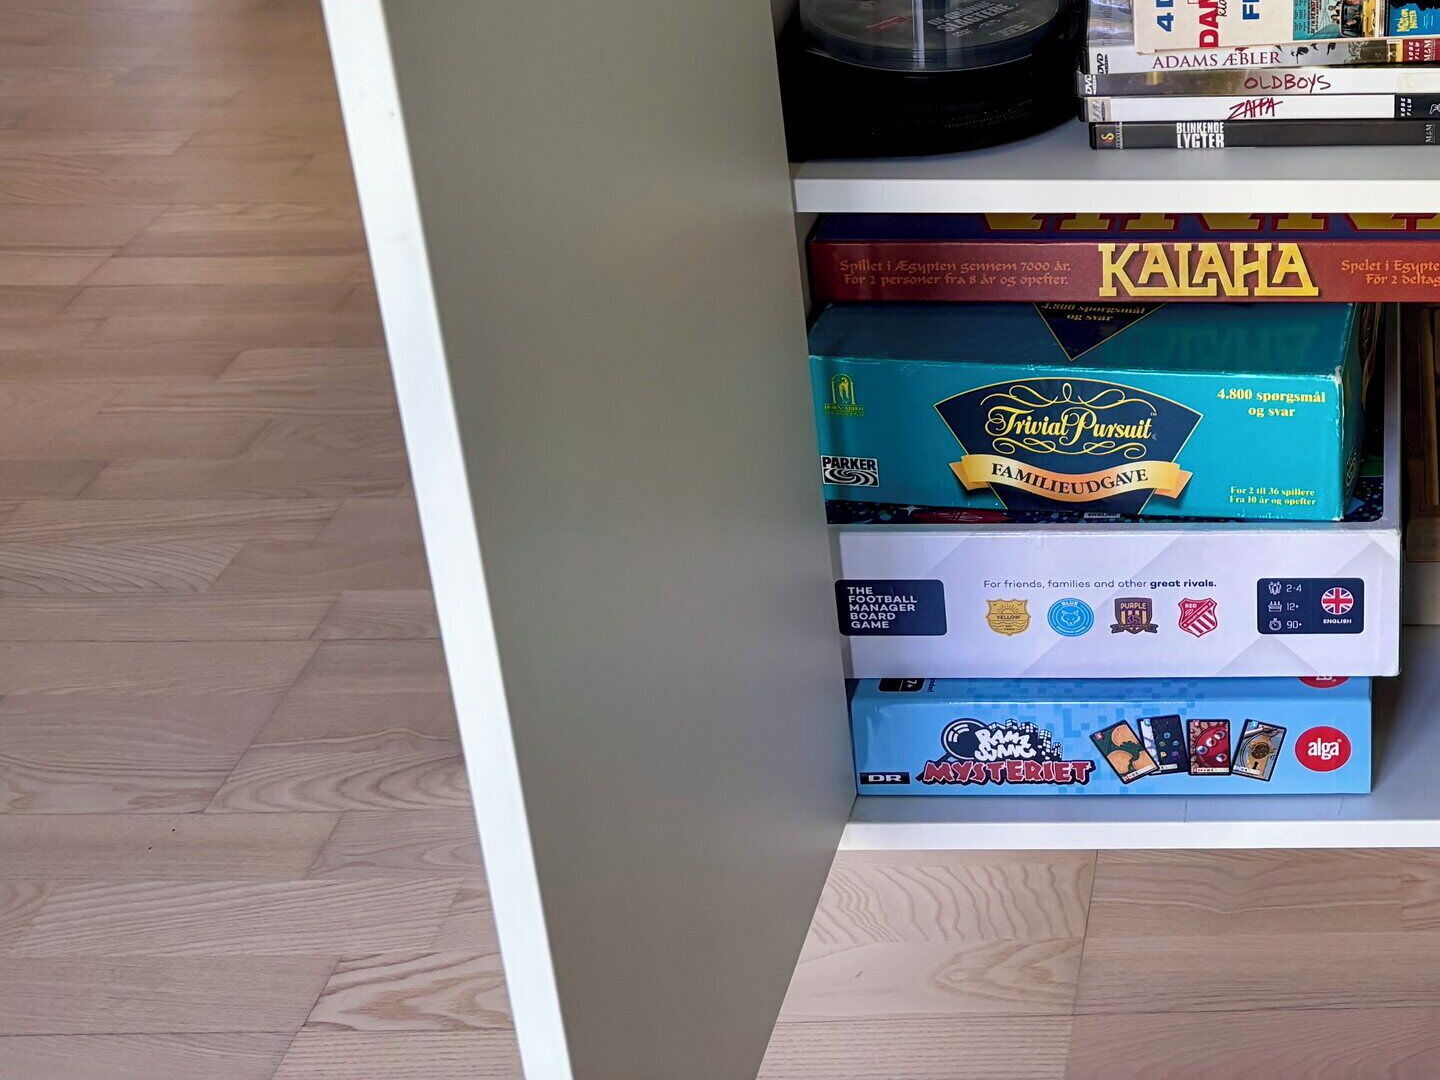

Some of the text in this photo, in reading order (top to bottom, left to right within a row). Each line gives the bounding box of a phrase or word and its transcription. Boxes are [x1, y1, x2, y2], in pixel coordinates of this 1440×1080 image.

[1156, 12, 1174, 32] 4
[1152, 51, 1282, 69] ADAMS ÆBLER
[1245, 74, 1332, 95] OLDBOYS
[1227, 96, 1284, 120] ZAPPA
[1176, 122, 1225, 134] BLINKENDE
[1176, 133, 1225, 149] LYGTER
[1097, 242, 1319, 297] KALAHA
[1341, 260, 1383, 275] Spelet
[1216, 388, 1326, 404] 4.800 spørgsmål
[1247, 407, 1296, 418] og svar
[985, 406, 1153, 446] Trivial Pursuit
[822, 456, 877, 471] PARKER
[991, 462, 1149, 495] FAMILIEUDGAVE
[1230, 485, 1246, 495] For
[1256, 486, 1266, 495] til
[1281, 488, 1315, 499] spillere
[847, 586, 874, 595] THE
[1286, 584, 1303, 593] 2-4
[848, 594, 918, 604] FOOTBALL
[849, 603, 916, 613] MANAGER
[850, 612, 896, 621] BOARD
[851, 620, 890, 630] GAME
[1307, 739, 1341, 760] alga
[867, 774, 903, 783] DR
[923, 760, 1094, 785] MYSTERIET
